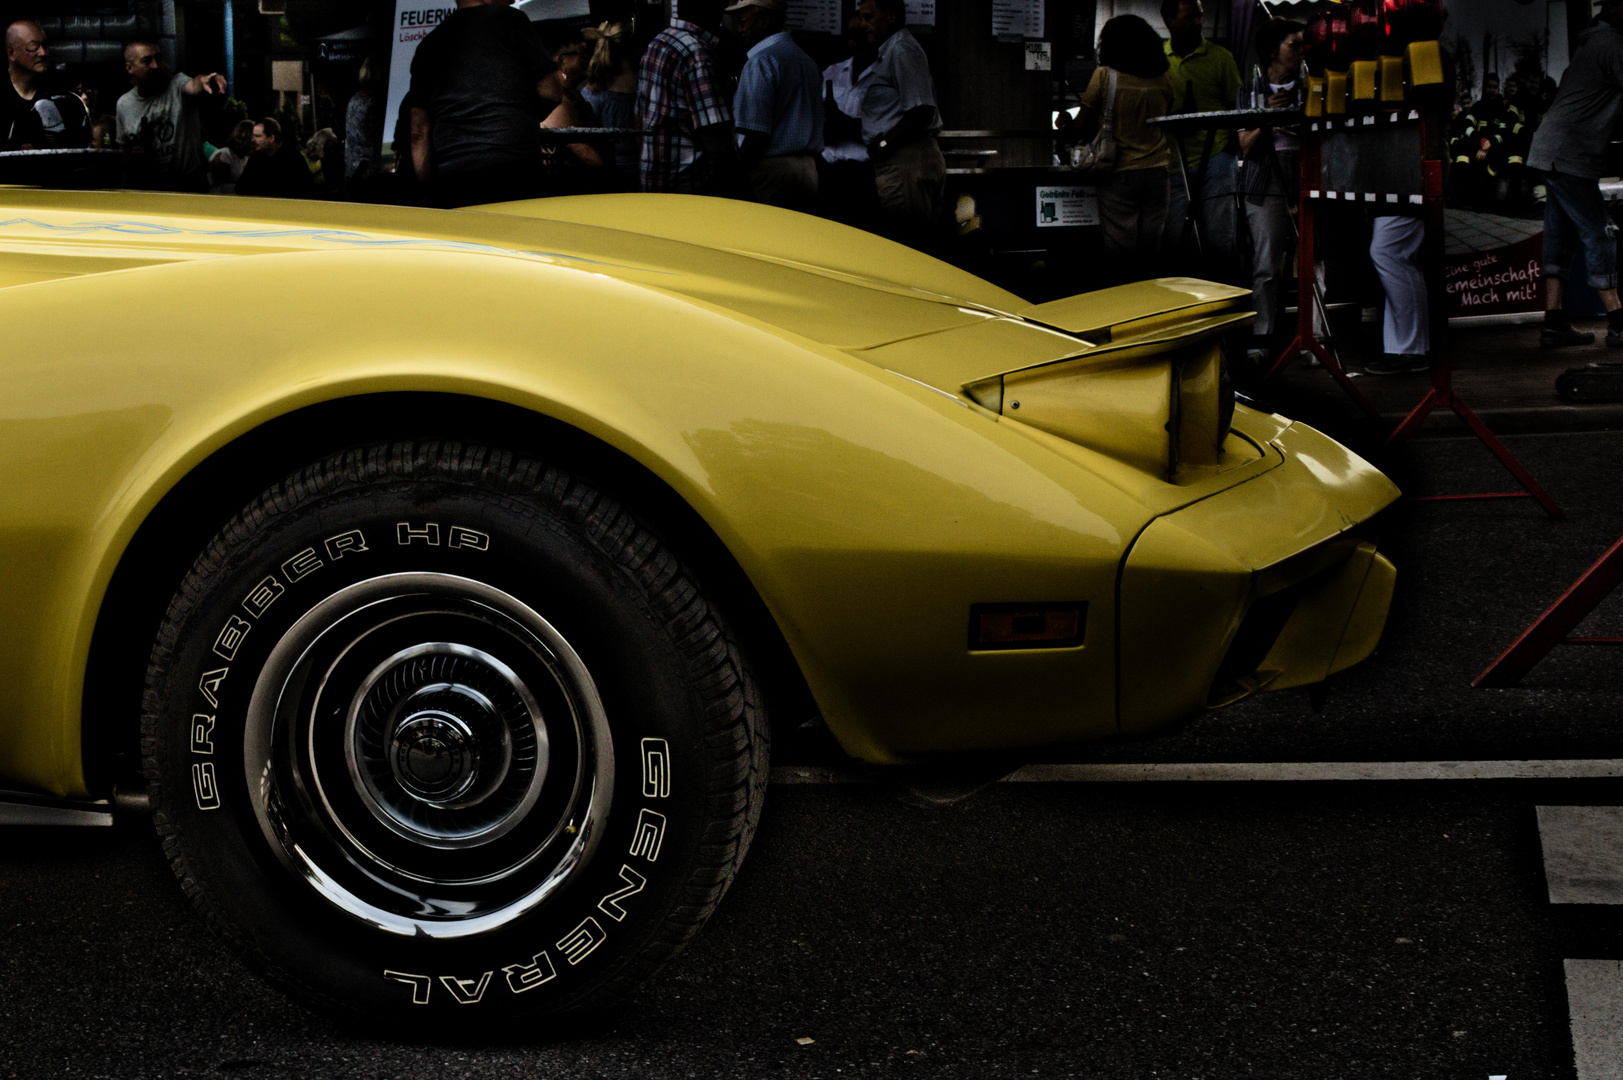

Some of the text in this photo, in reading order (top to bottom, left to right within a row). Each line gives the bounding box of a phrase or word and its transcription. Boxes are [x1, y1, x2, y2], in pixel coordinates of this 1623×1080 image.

[1460, 282, 1537, 307] Mach mit!
[1473, 253, 1498, 273] gute
[190, 522, 490, 811] GRABBER HP
[383, 737, 671, 1005] GENERAL
